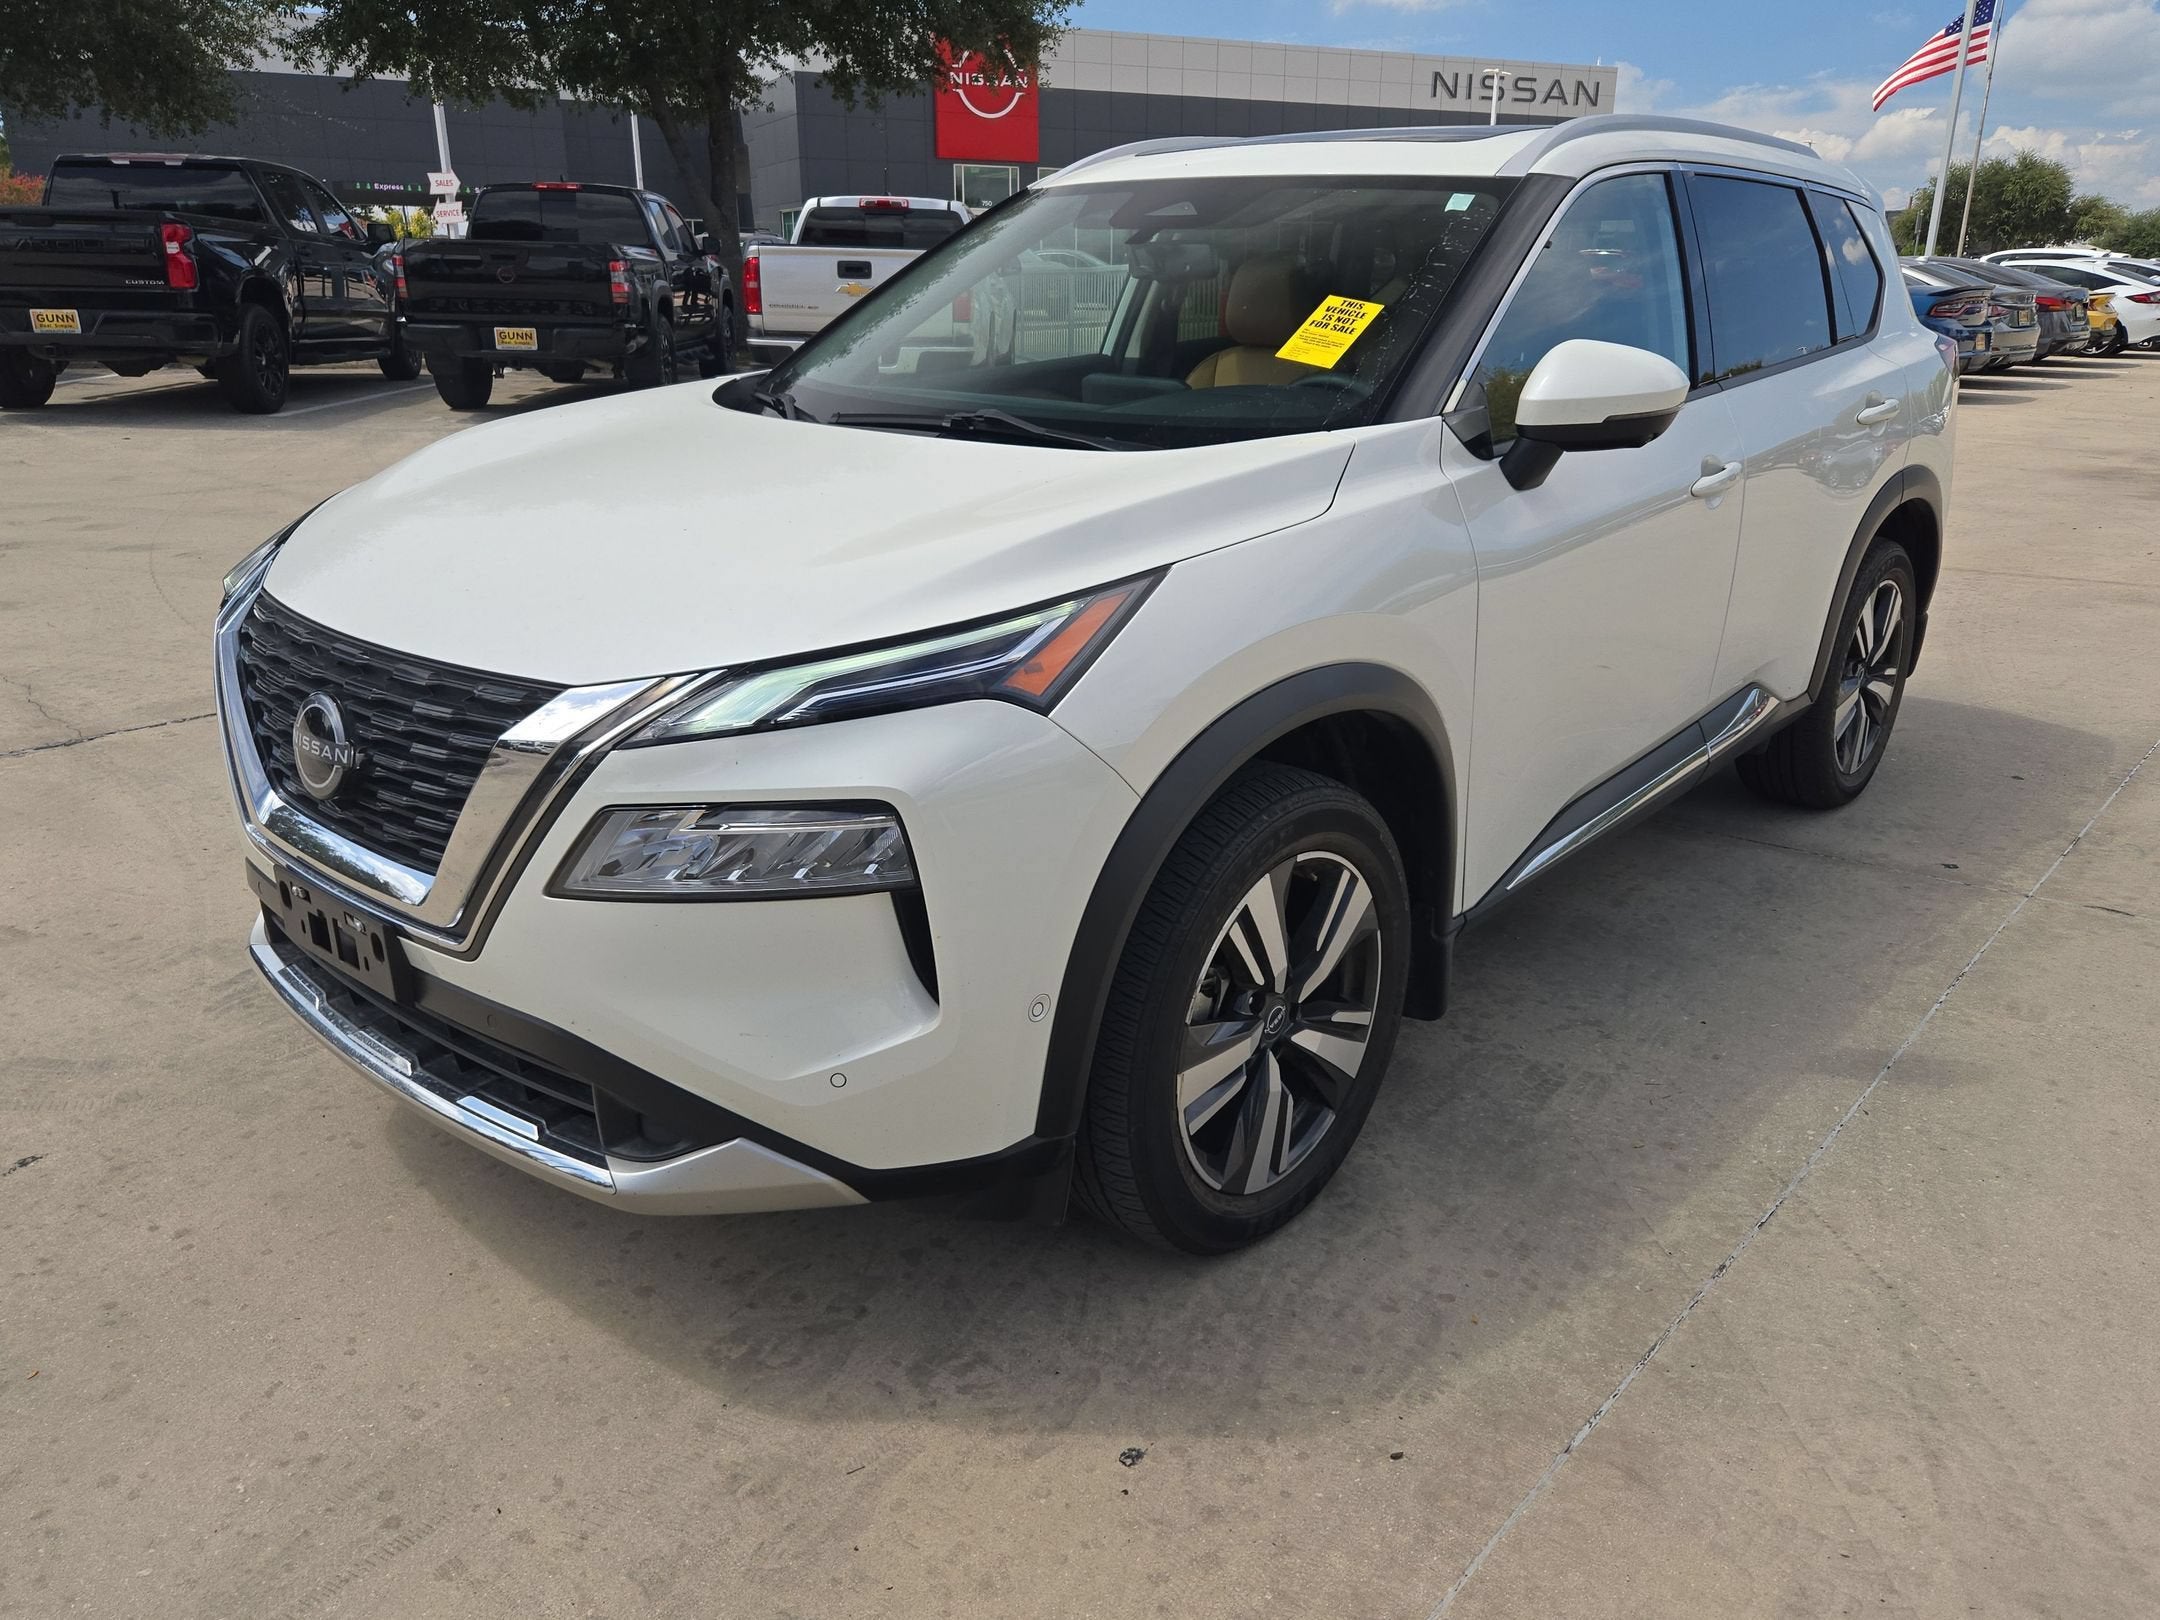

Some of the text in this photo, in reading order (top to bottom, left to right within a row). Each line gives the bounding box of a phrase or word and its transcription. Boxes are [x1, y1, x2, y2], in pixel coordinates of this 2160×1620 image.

[950, 71, 1028, 88] NISAN
[1431, 70, 1600, 107] NISSAN
[374, 183, 404, 191] Express
[435, 179, 454, 187] SALES
[436, 209, 460, 218] SERVICE
[1341, 300, 1365, 309] THIS
[36, 313, 75, 323] GUNN
[1326, 306, 1367, 319] VEHICLE
[1322, 313, 1358, 326] IS NOT
[1309, 320, 1356, 334] FOR SALE
[499, 331, 532, 341] GUNN
[294, 730, 348, 764] NISSAN
